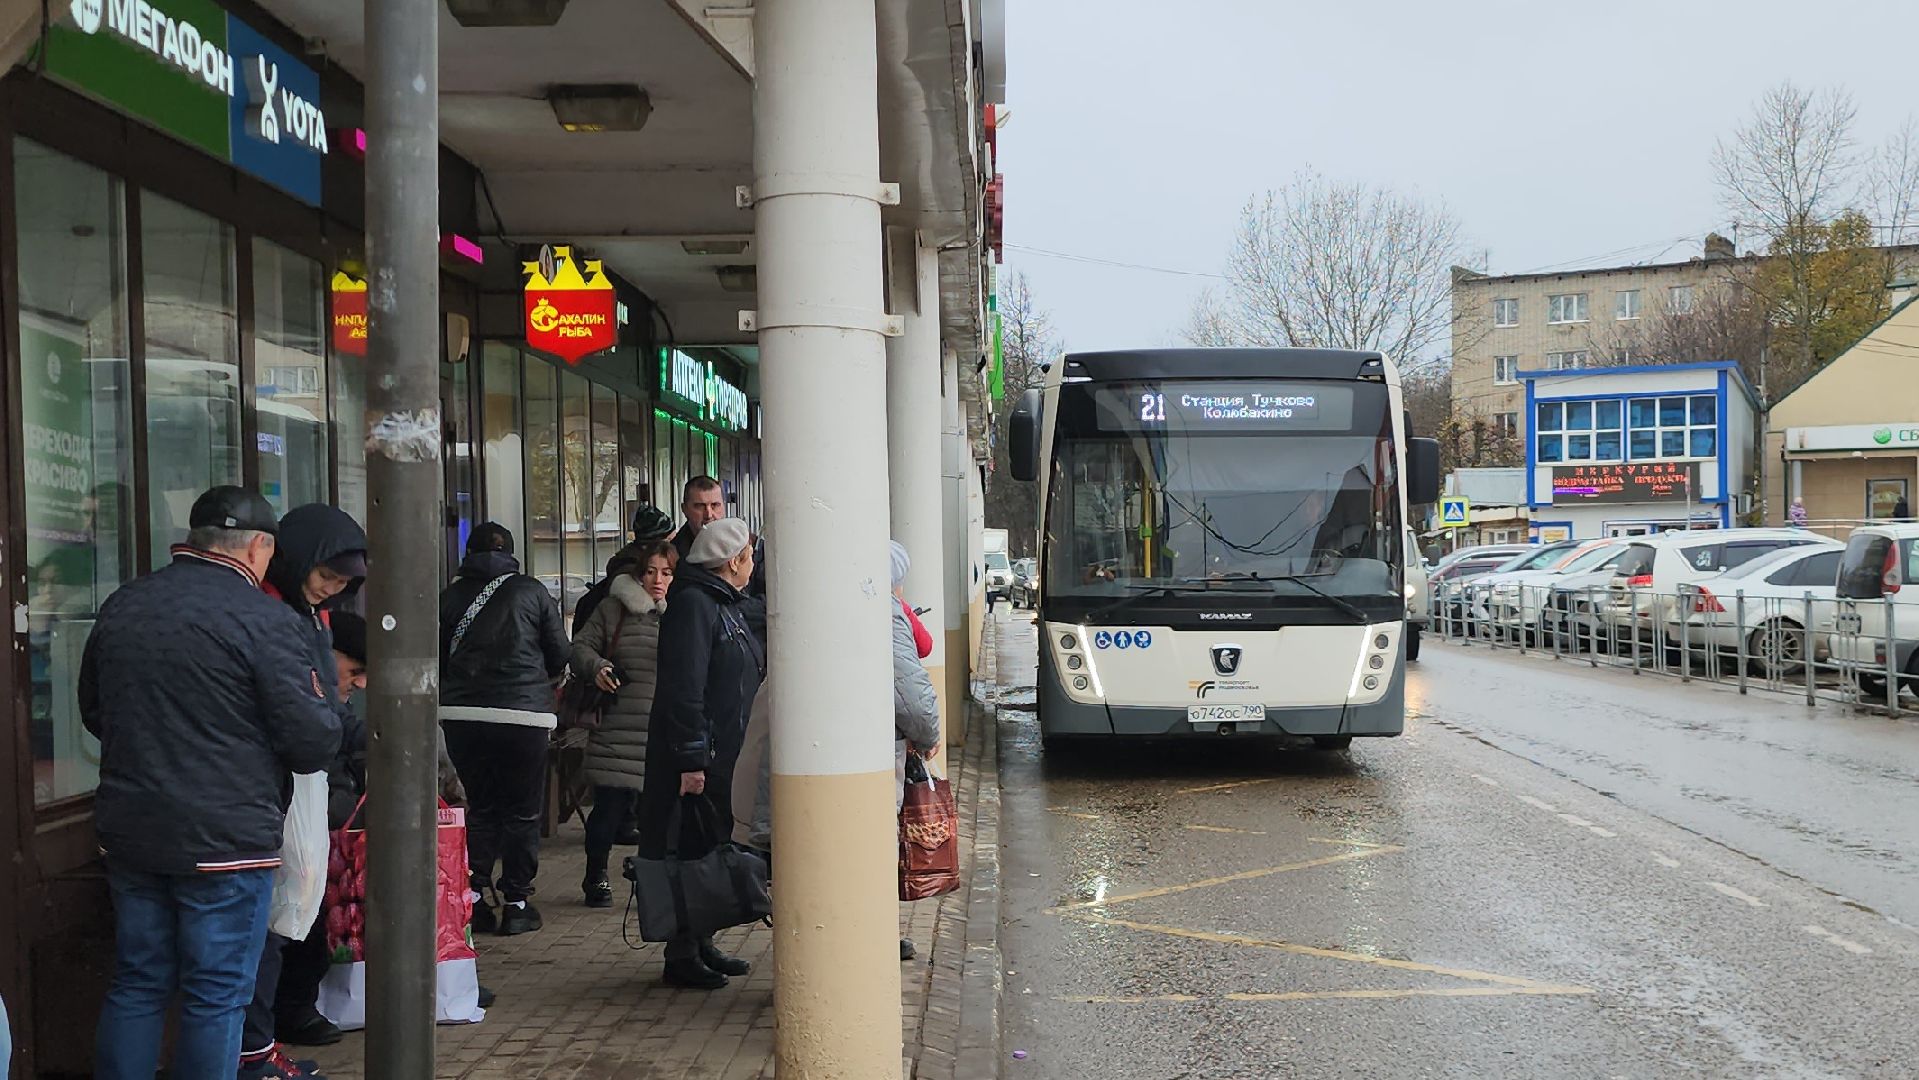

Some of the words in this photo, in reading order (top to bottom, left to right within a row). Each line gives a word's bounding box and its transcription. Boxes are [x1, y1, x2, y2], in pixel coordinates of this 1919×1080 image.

[108, 0, 234, 96] МЕГАФОН
[281, 86, 328, 154] YOTA
[530, 305, 606, 332] САХАЛИН
[558, 327, 592, 337] РЫБА
[672, 349, 706, 406] АПТЕКИ
[1141, 394, 1165, 421] 21
[1181, 394, 1243, 407] Станция
[1252, 394, 1315, 407] Тучково
[1203, 406, 1292, 419] Колюбакино
[1242, 705, 1262, 715] 790
